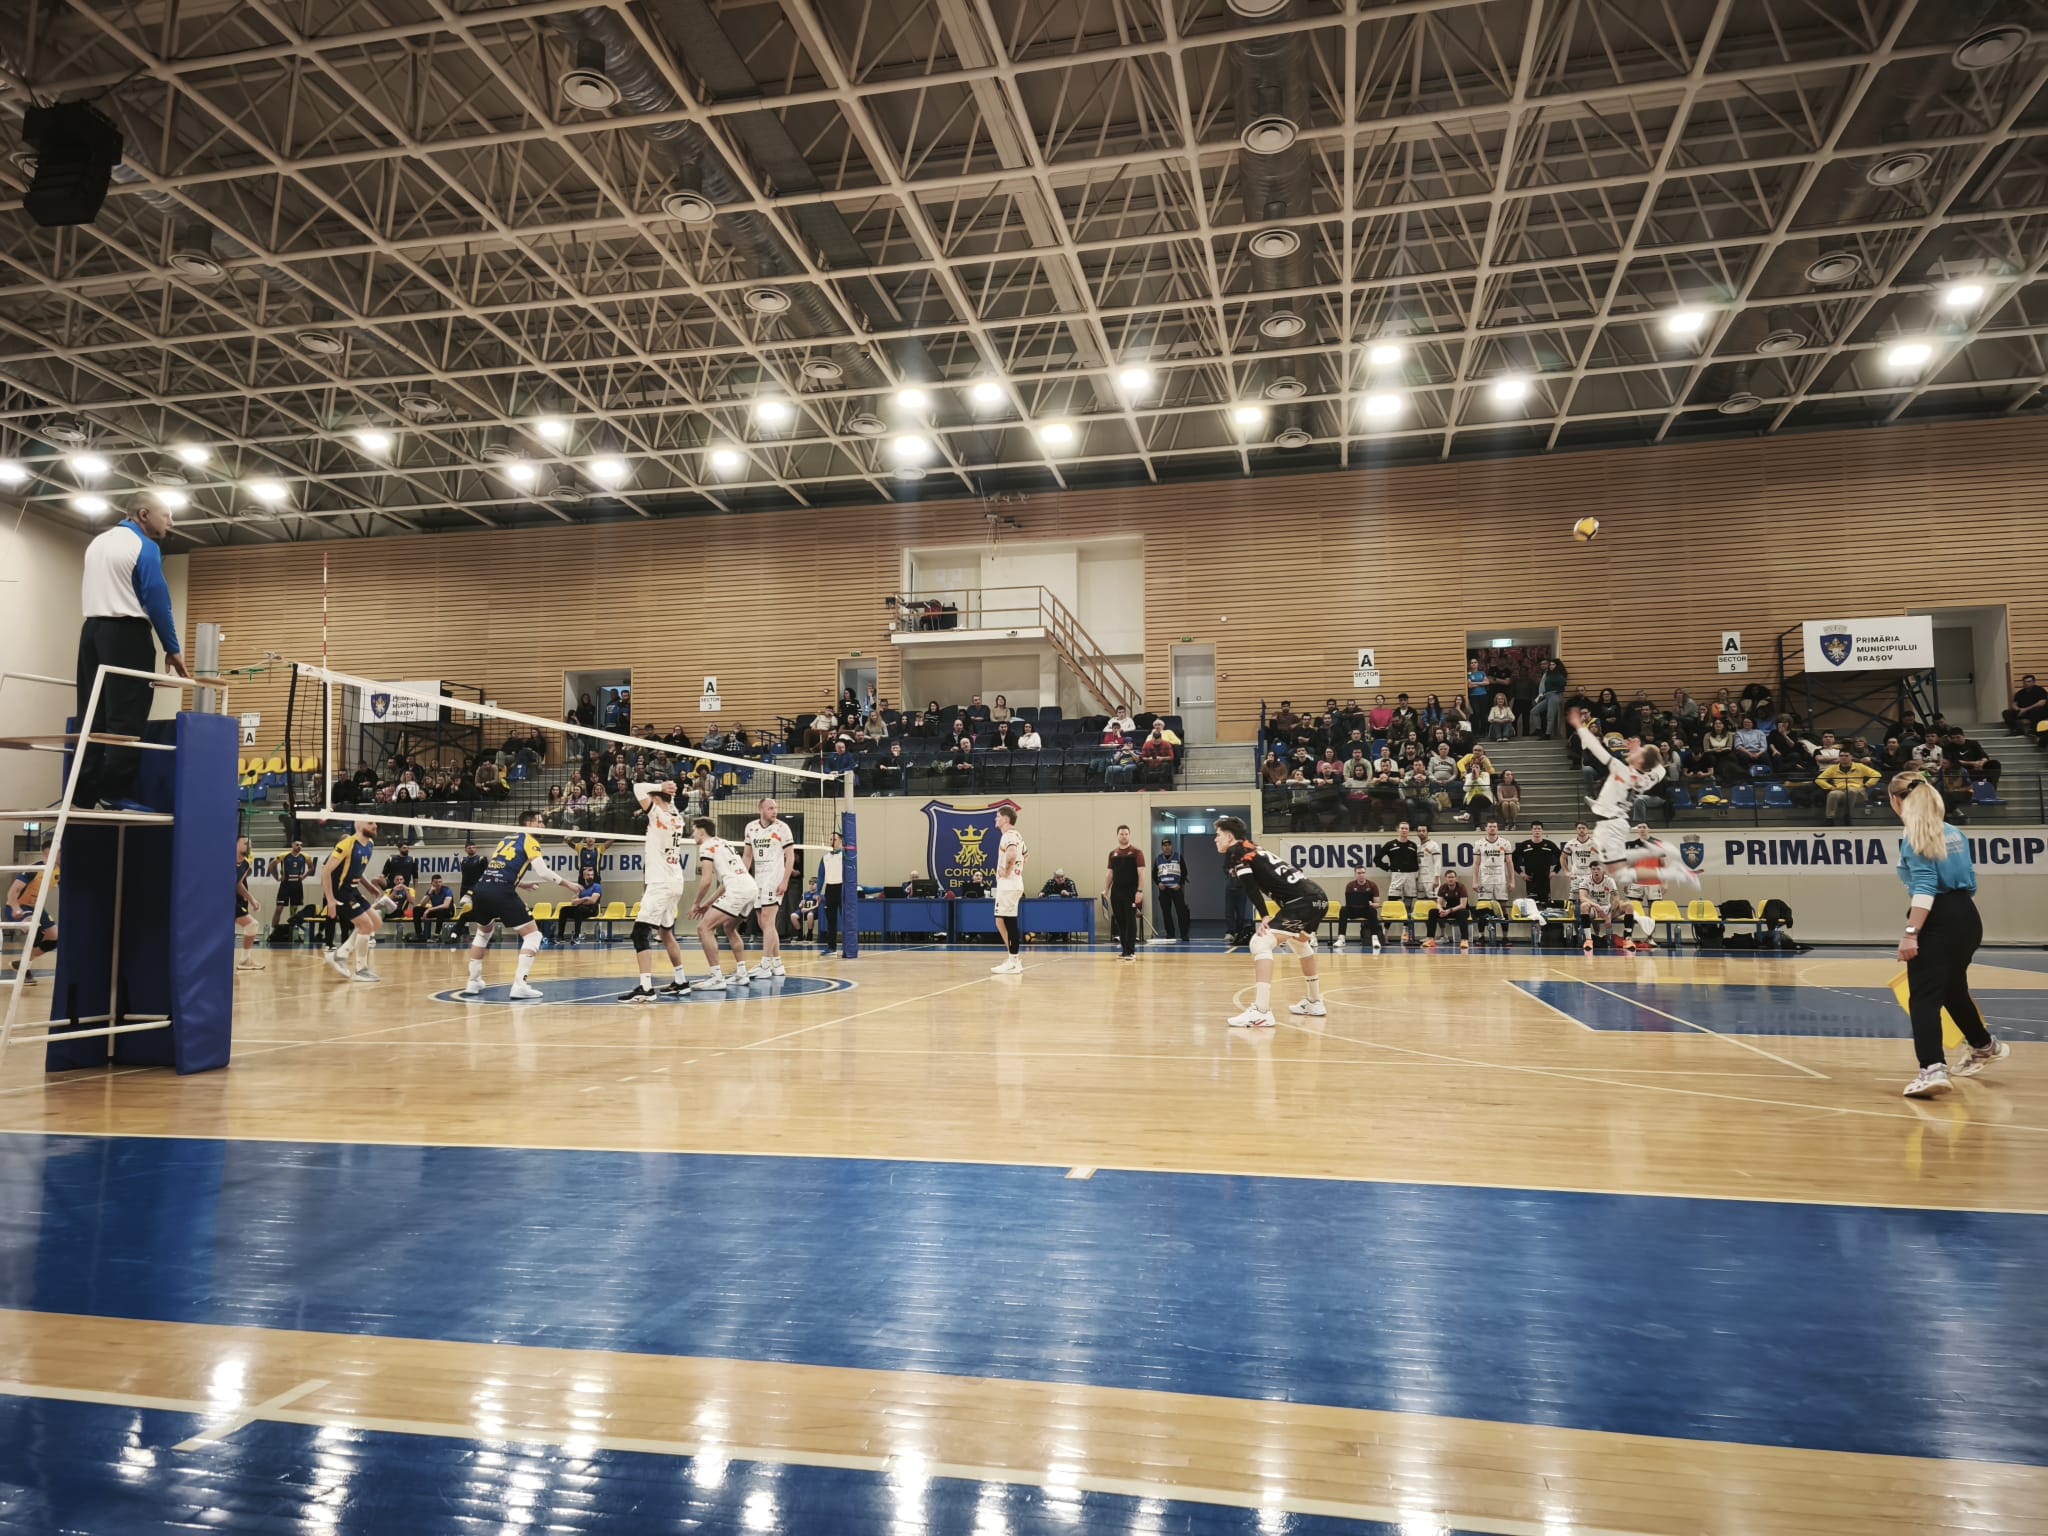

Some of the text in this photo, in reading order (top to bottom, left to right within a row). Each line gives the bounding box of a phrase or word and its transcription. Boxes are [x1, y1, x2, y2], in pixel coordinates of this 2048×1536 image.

[1725, 637, 1738, 651] A
[1856, 634, 1900, 643] PRIMĂRIA
[1857, 644, 1917, 652] MUNICIPIULUI
[1361, 655, 1372, 667] A
[706, 681, 715, 693] A
[245, 732, 254, 743] A
[1725, 832, 1888, 866] PRIMĂRIA
[619, 854, 689, 870] BRV
